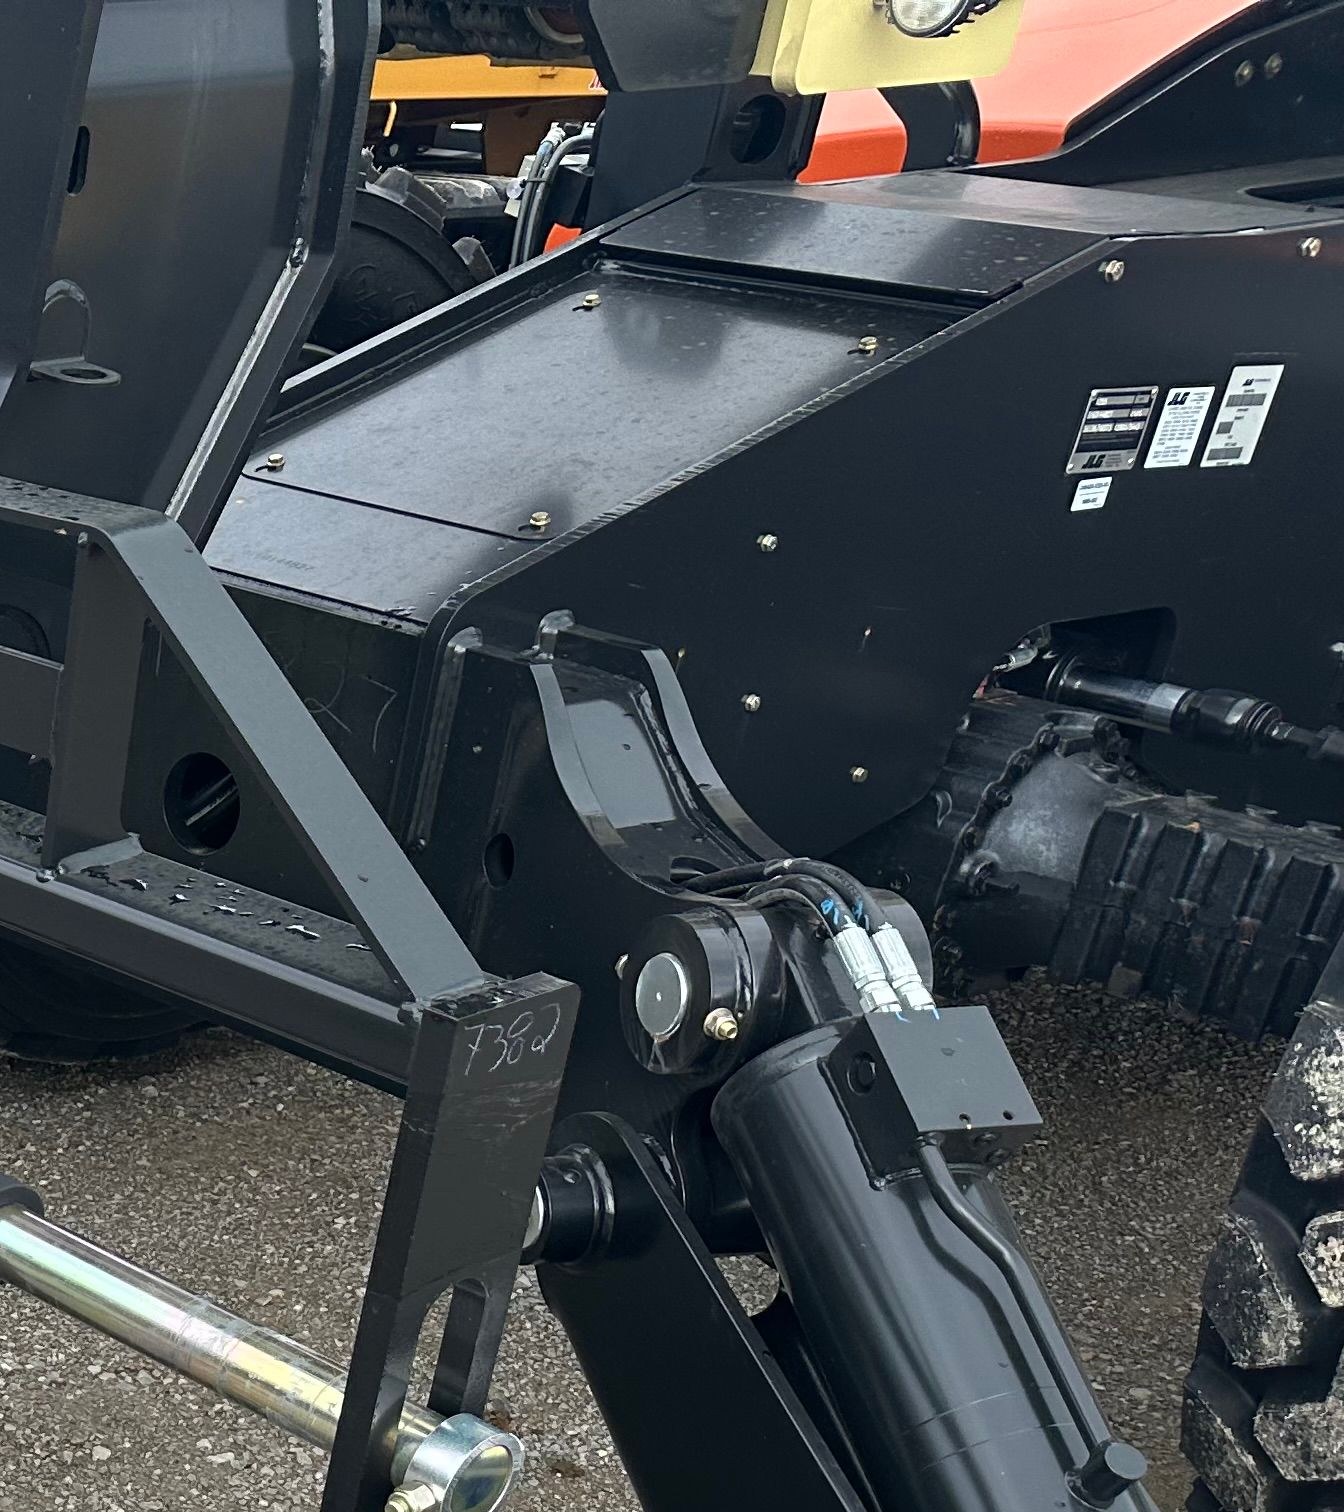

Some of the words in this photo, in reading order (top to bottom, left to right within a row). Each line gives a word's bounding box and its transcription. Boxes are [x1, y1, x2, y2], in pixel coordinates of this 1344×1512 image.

[1167, 391, 1190, 406] JLG
[1081, 454, 1107, 469] JLG
[464, 1002, 561, 1077] 7382
